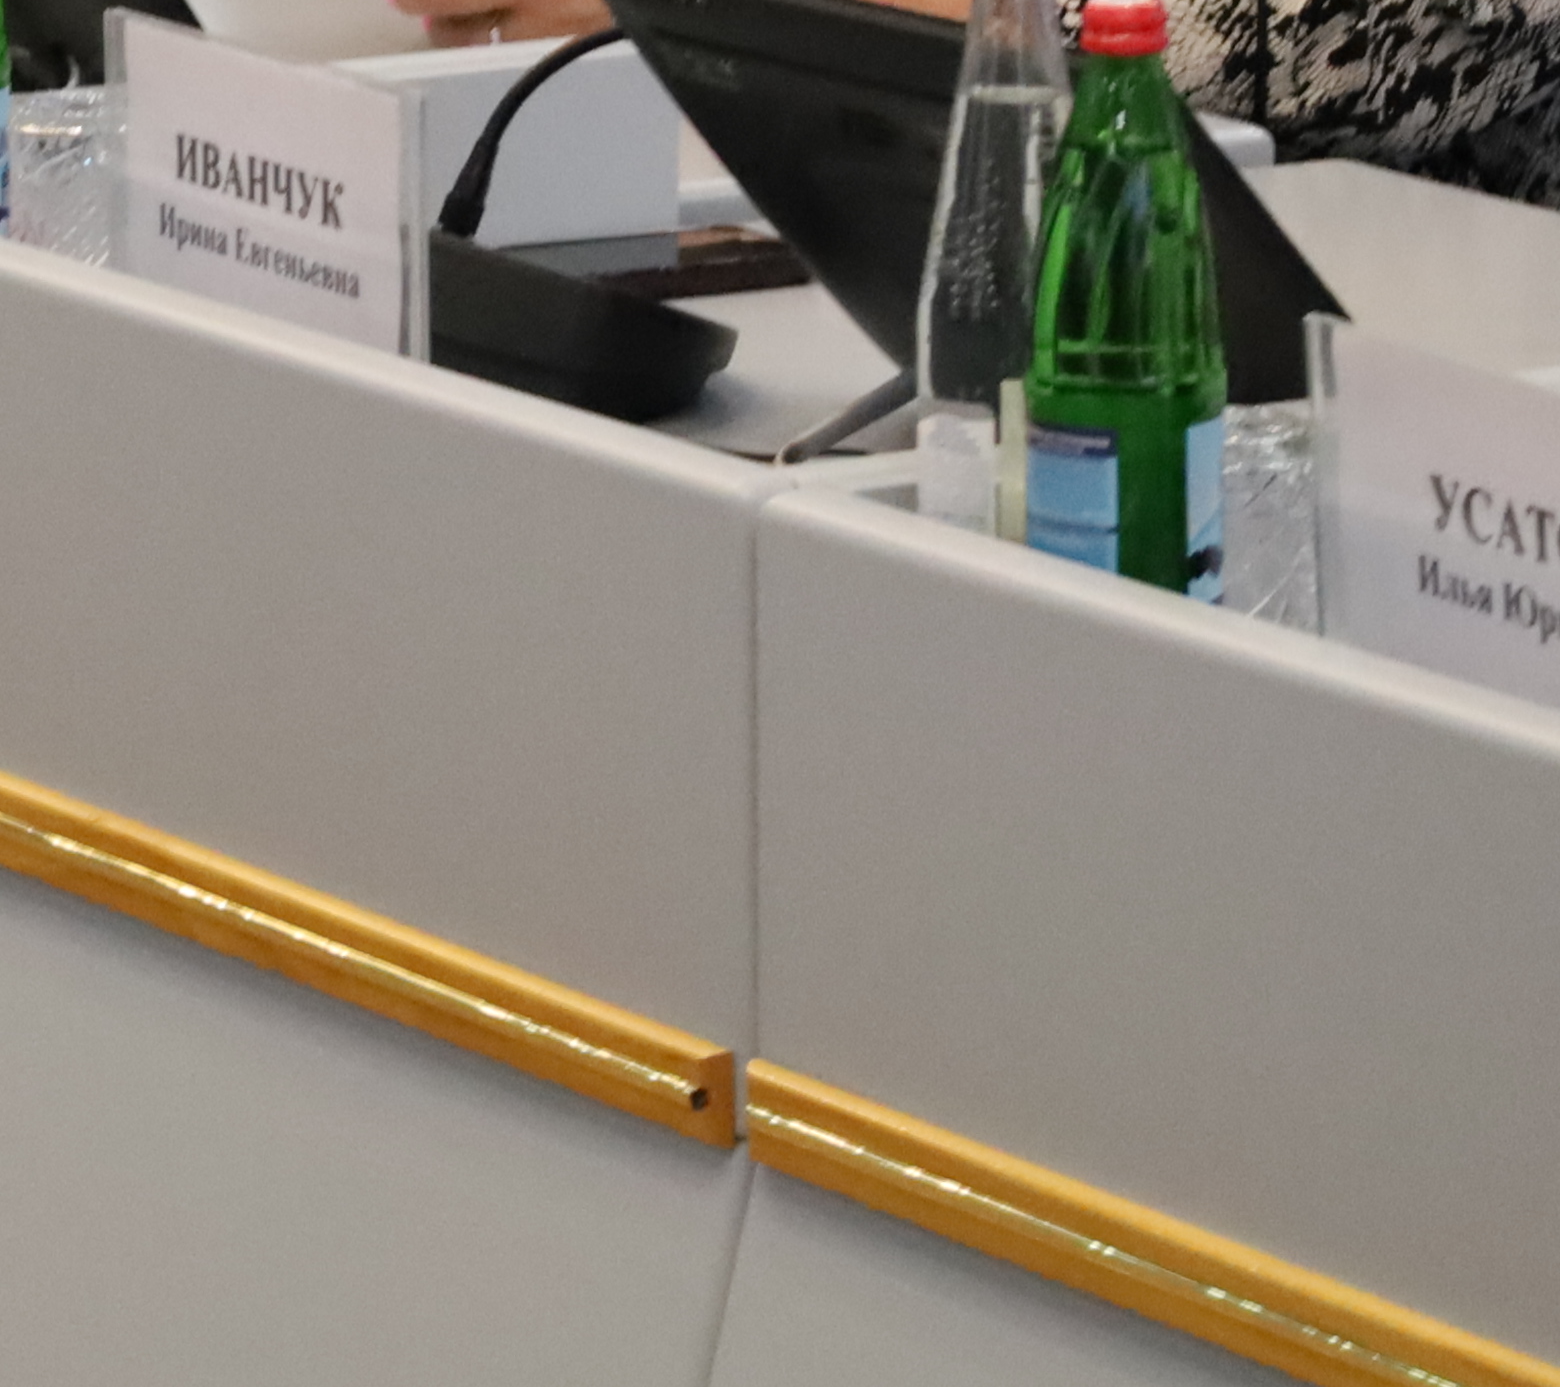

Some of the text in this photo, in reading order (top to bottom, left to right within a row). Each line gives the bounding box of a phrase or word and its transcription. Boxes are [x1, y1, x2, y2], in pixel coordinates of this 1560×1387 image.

[177, 134, 344, 230] ИВАНЧУК
[159, 203, 360, 299] Ирина Евгеньевна
[1418, 555, 1494, 615] Илья
